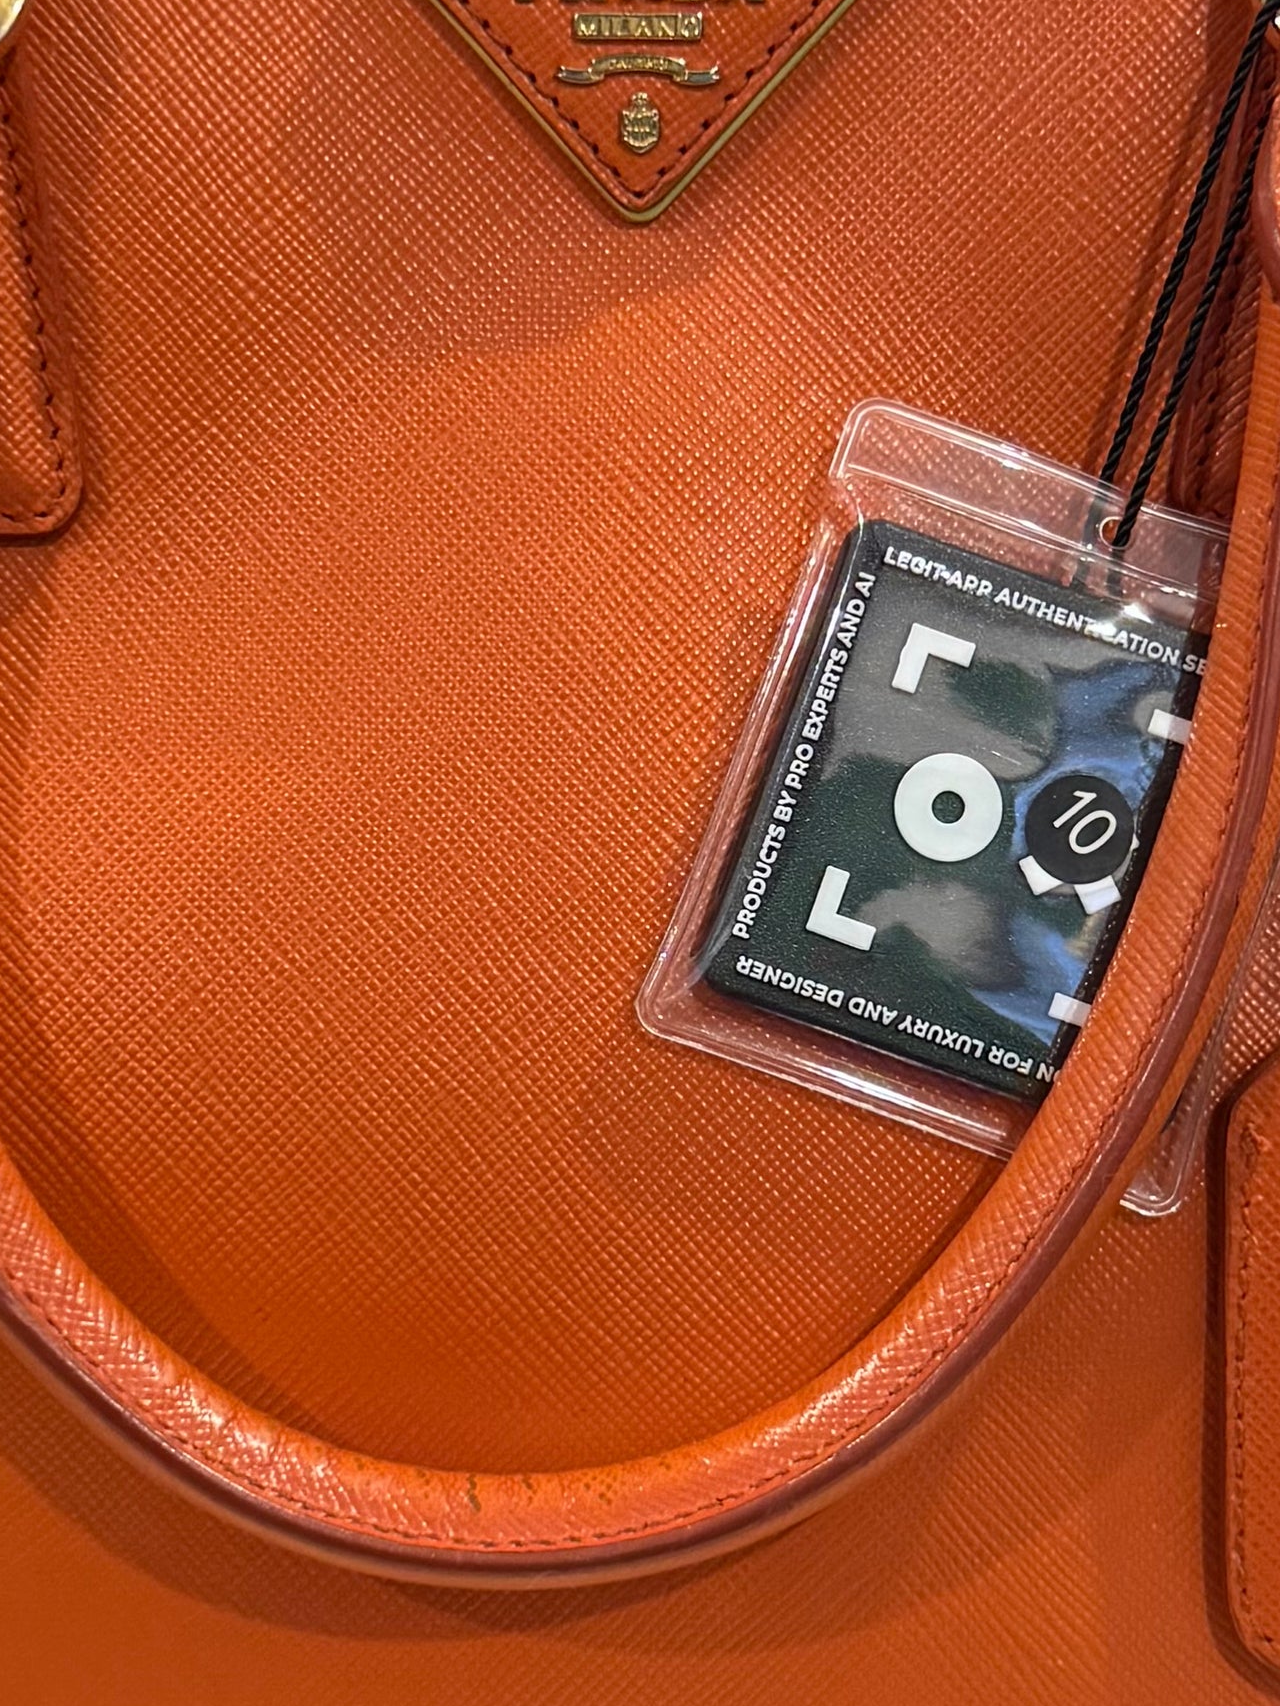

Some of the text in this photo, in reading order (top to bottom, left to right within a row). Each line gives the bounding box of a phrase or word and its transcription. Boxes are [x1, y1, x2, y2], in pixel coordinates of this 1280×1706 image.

[577, 16, 701, 37] MILANO
[994, 587, 1180, 667] AUTHENTCATION
[732, 571, 876, 939] PRODUCTS BY PRO EXPERTS AND AI
[1053, 790, 1117, 855] 10
[735, 954, 845, 1009] DESIGNER
[847, 995, 898, 1027] AND
[897, 1018, 984, 1059] LUXURY
[987, 1044, 1034, 1075] FOR
